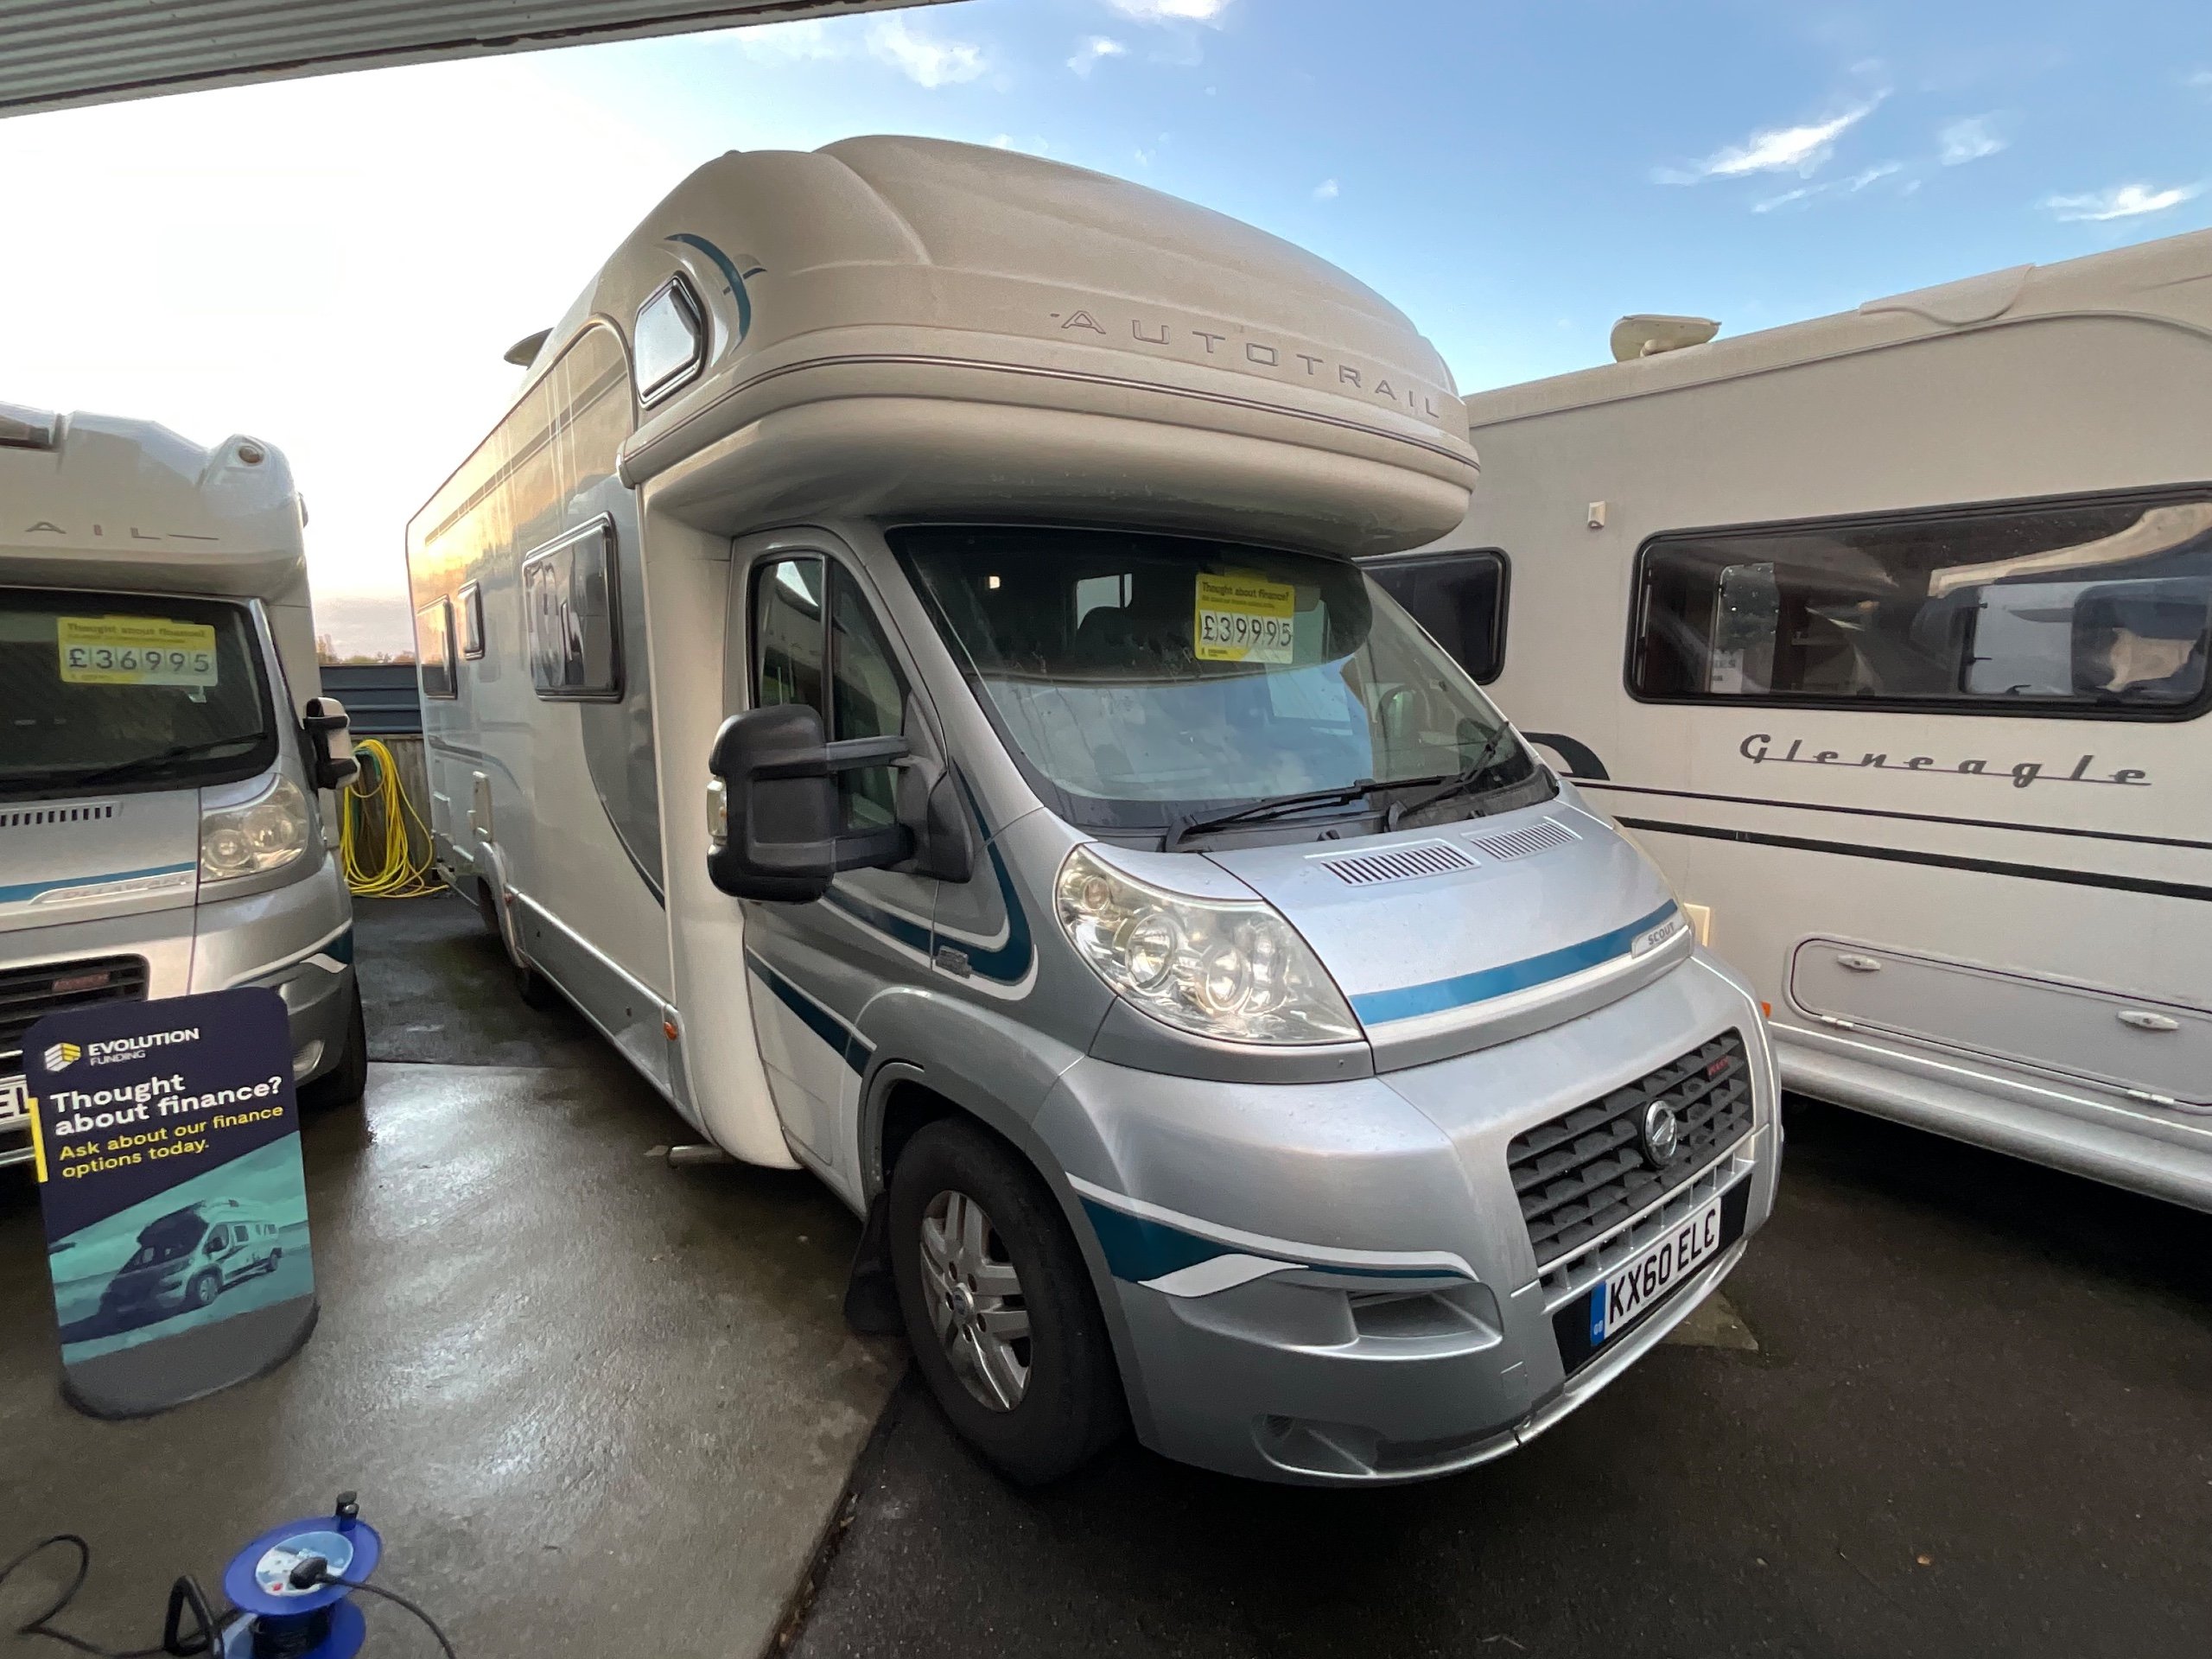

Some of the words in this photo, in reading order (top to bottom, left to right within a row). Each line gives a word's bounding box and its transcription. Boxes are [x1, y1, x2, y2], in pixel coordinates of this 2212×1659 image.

[1061, 309, 1439, 419] AUTOTRAIL
[1203, 615, 1292, 646] £39995
[69, 648, 209, 673] £36995
[1739, 733, 2148, 788] Gleneagle
[1648, 922, 1675, 945] SCOUT
[88, 1028, 200, 1056] EVOLUTION
[90, 1050, 146, 1066] FUNDING
[50, 1074, 186, 1113] Thought
[55, 1103, 150, 1135] about
[157, 1076, 283, 1116] finance?
[59, 1141, 99, 1160] Ask
[107, 1128, 168, 1150] about
[174, 1121, 207, 1137] our
[213, 1106, 283, 1128] finance
[62, 1152, 142, 1179] options
[148, 1139, 209, 1160] today.
[1610, 1243, 1672, 1325] KX60
[1677, 1209, 1716, 1272] ELC
